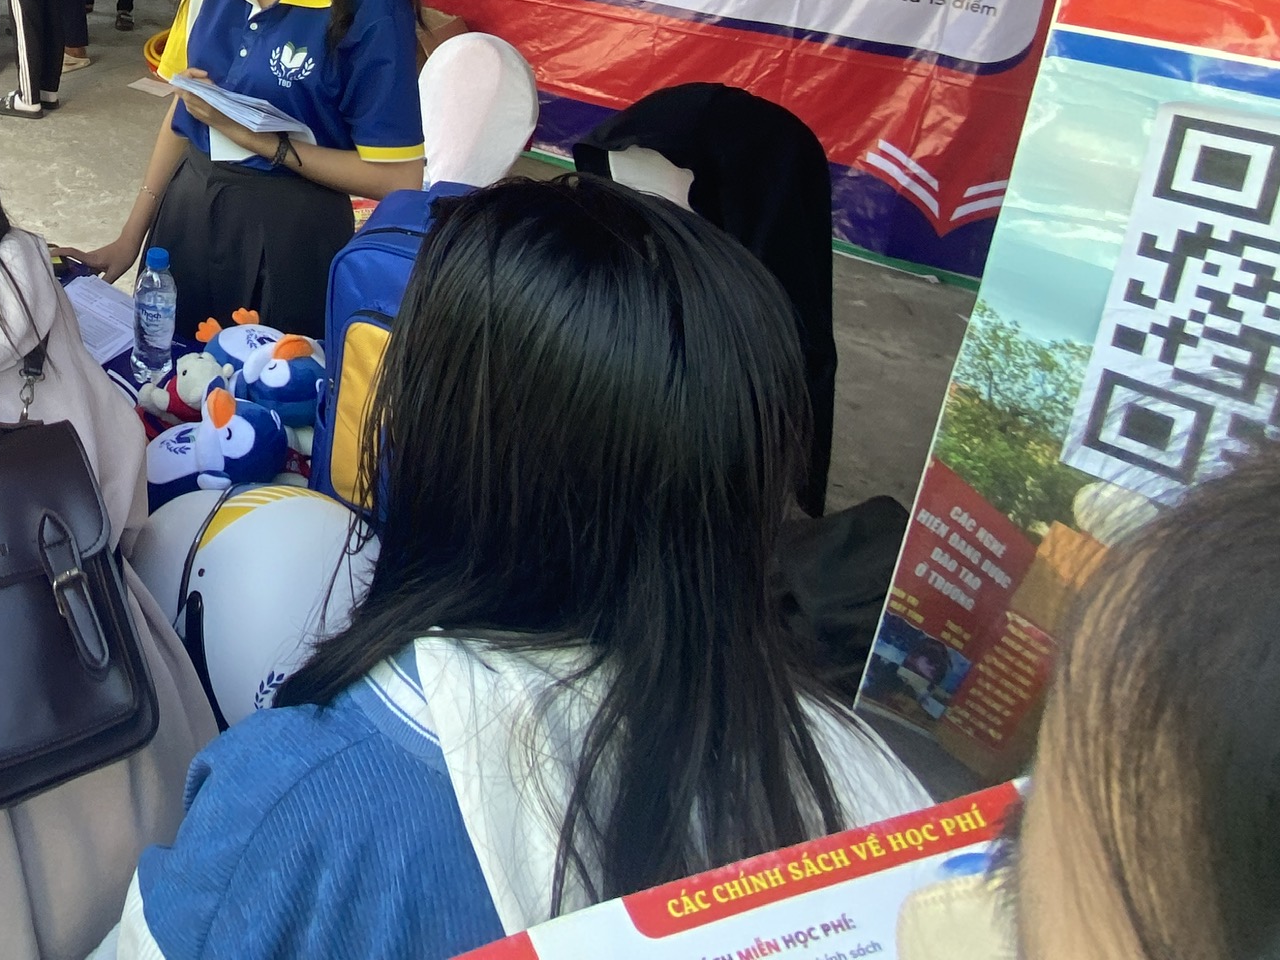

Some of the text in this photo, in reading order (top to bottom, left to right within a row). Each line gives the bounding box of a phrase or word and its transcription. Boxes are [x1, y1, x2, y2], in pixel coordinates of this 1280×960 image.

[278, 78, 291, 88] TBD
[667, 802, 987, 917] CÁC CHÍNH SÁCH VỀ HỌC PHÍ
[781, 927, 820, 949] HỌC
[820, 912, 857, 937] PHÍ:
